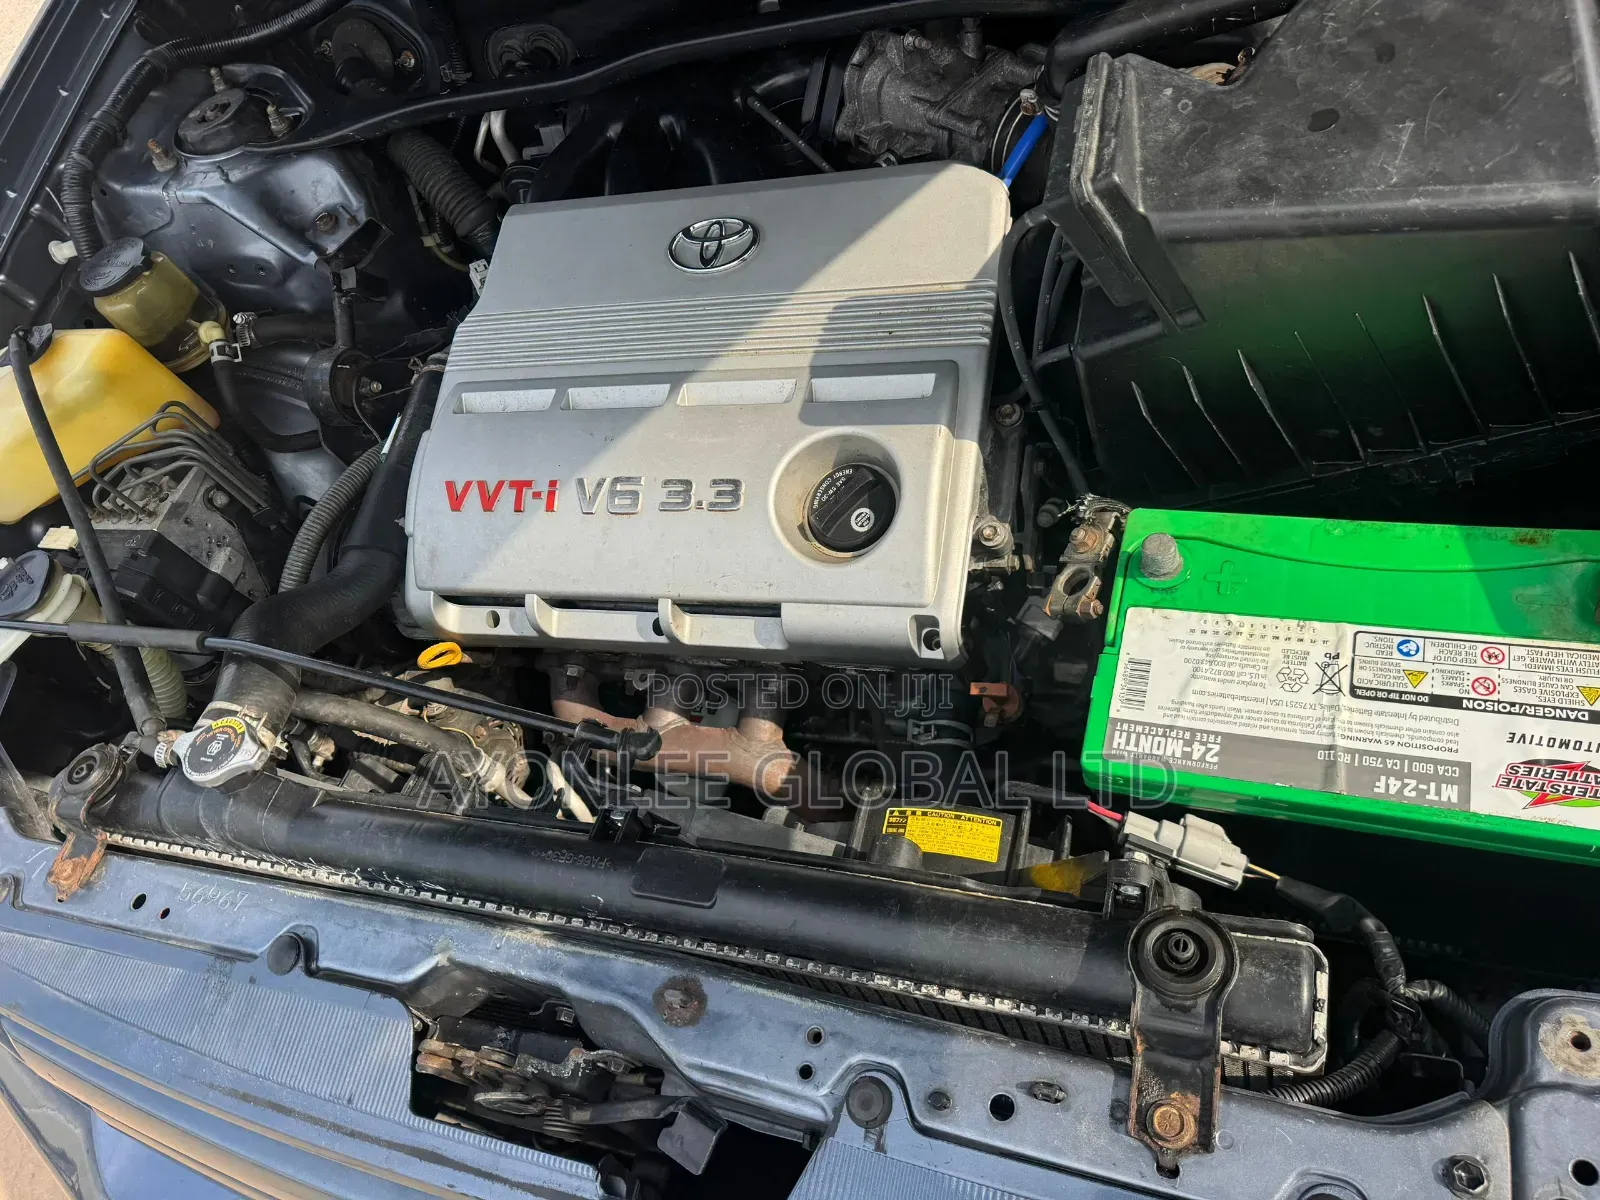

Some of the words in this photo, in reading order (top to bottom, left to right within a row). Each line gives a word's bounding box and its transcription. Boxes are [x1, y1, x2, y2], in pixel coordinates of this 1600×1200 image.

[444, 479, 560, 513] VVT-i
[575, 476, 646, 515] V6
[658, 478, 746, 512] 3.3
[1428, 640, 1465, 649] CHILDREN.
[1281, 647, 1309, 656] RECYCLED
[1323, 650, 1339, 661] Pb
[1438, 648, 1462, 656] REACH
[1524, 648, 1542, 656] FAST.
[1544, 649, 1563, 657] HELP
[1565, 651, 1599, 661] MEDICAL
[1281, 658, 1306, 666] BATTERY
[1458, 656, 1476, 664] KEEP
[1511, 654, 1525, 662] GET
[1556, 658, 1575, 666] WITH
[1237, 662, 1260, 671] Canada
[1574, 659, 1599, 668] ATELY
[1368, 665, 1400, 673] BLINDNESS
[1434, 667, 1465, 675] SMOKING
[1555, 664, 1573, 673] EYES
[1575, 666, 1599, 675] FLUSH
[1216, 677, 1235, 685] under
[1235, 678, 1257, 688] replace
[1374, 679, 1407, 688] SULFURIC
[1500, 677, 1536, 686] BLINDNESS
[1537, 681, 1557, 689] CAUSE
[1353, 687, 1375, 696] OPEN.
[1513, 685, 1537, 694] GASES
[1537, 687, 1579, 698] EXPLOSIVE
[1190, 688, 1265, 704] interstatebatteries.com
[1400, 692, 1416, 700] NOT
[1416, 694, 1428, 702] DO
[1535, 695, 1555, 703] EYES.
[1268, 698, 1283, 706] USA
[1284, 699, 1307, 709] 75251
[1308, 702, 1316, 710] TX
[1557, 697, 1585, 706] SHIELD
[1462, 698, 1589, 721] DANGER/POISON
[1244, 714, 1262, 722] cancer
[1286, 713, 1313, 721] California
[1373, 709, 1407, 720] Interstate
[1408, 711, 1417, 721] by
[1287, 720, 1314, 729] California
[1353, 720, 1373, 728] known
[1418, 714, 1459, 726] Distributed
[1114, 721, 1190, 738] REPLACEMENT
[1238, 721, 1257, 729] related
[1374, 723, 1404, 731] chemicals
[1354, 727, 1374, 735] known
[1375, 730, 1404, 739] chemicals
[1422, 728, 1445, 736] contain
[1194, 731, 1221, 742] FREE
[1111, 730, 1221, 762] 24-MONTH
[1396, 740, 1458, 753] PROPOSITION
[1505, 731, 1600, 753] TOMOTIVE
[1316, 748, 1335, 761] 110
[1336, 751, 1351, 763] RC
[1168, 757, 1218, 769] PERFORMANCE
[1361, 755, 1382, 767] 750
[1384, 757, 1400, 769] CA
[1411, 761, 1434, 773] 600
[1435, 764, 1459, 777] CCA
[1372, 774, 1459, 802] MT-24F
[927, 811, 955, 819] CAUTION
[960, 815, 998, 826] ATTENTION
